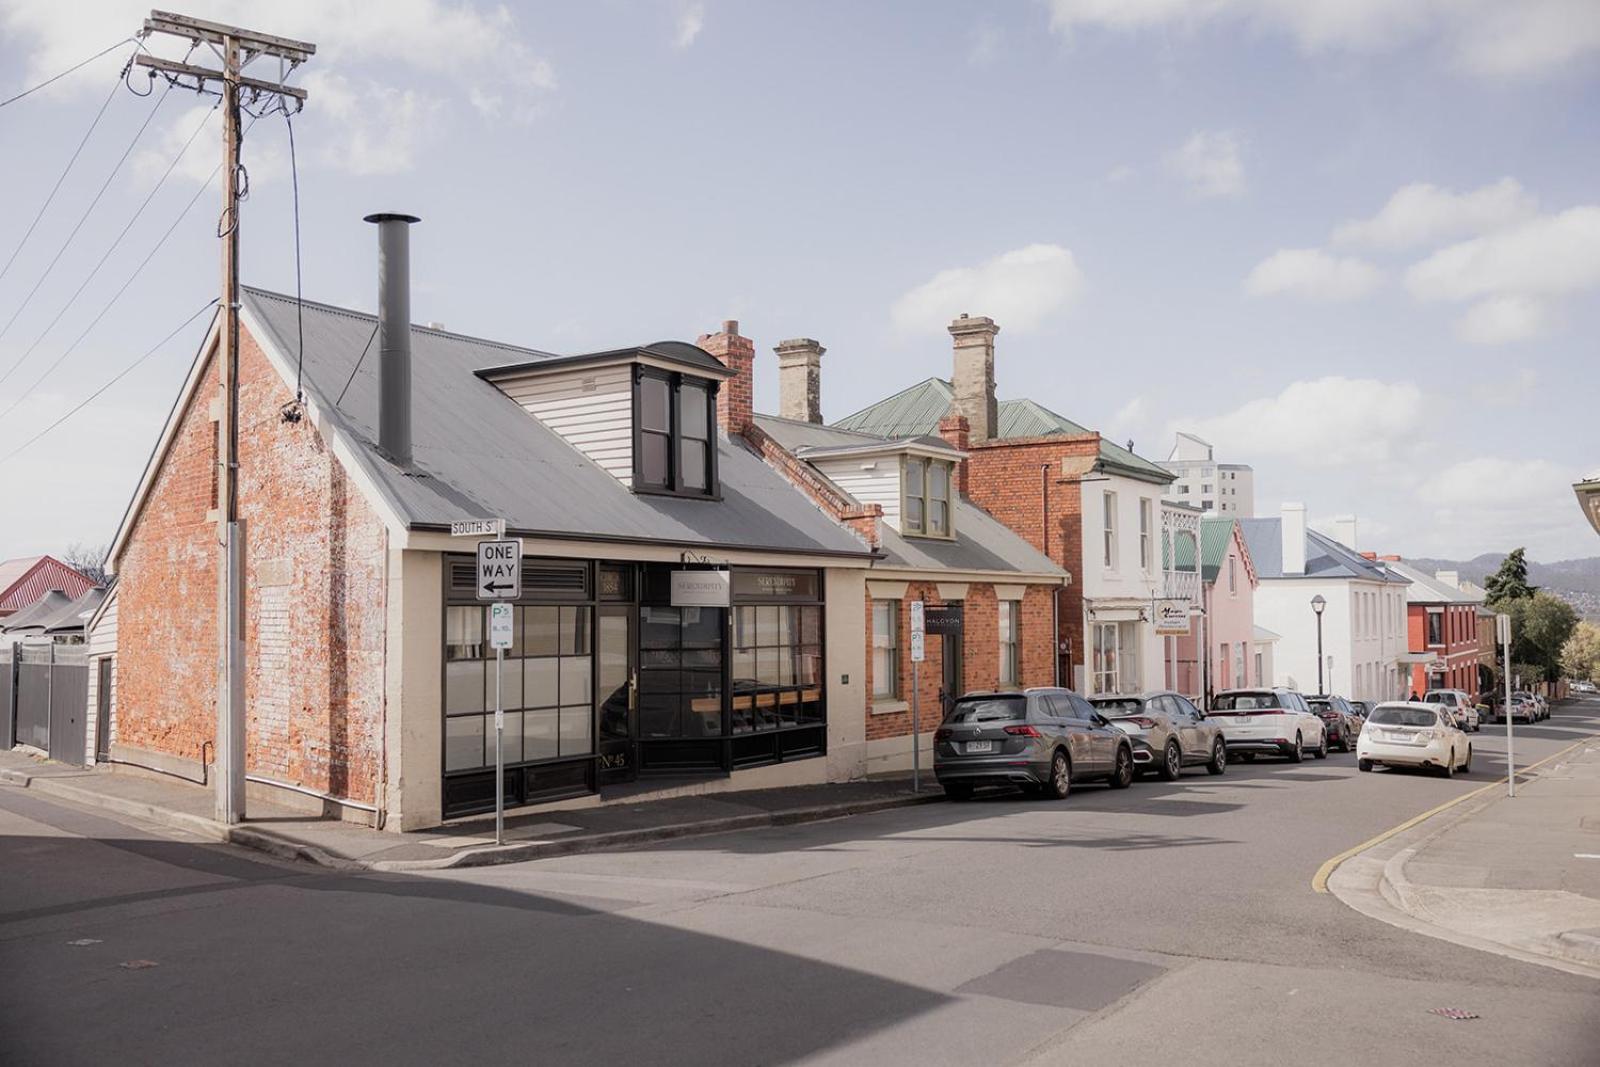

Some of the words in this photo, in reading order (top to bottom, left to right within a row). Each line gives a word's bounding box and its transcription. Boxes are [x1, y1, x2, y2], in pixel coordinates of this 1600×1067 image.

[453, 522, 482, 534] SOUTH
[485, 546, 513, 560] ONE
[483, 564, 514, 578] WAY
